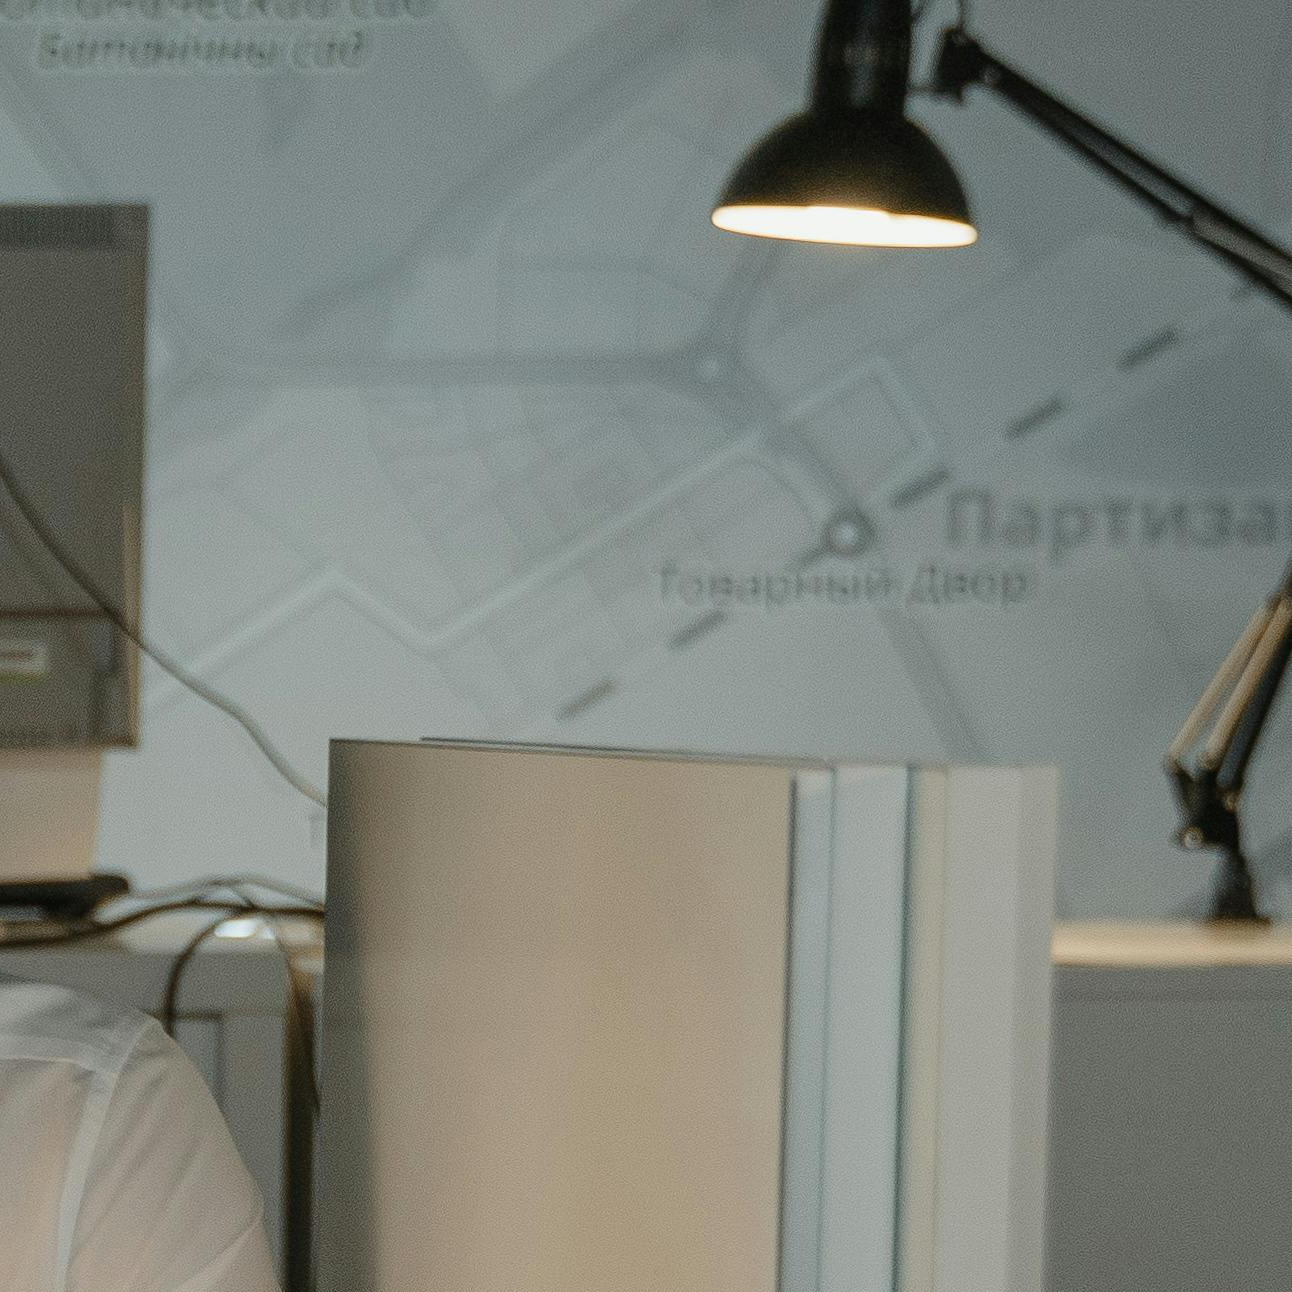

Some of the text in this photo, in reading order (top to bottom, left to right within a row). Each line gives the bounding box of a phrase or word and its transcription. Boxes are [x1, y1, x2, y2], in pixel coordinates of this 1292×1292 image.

[946, 488, 1292, 564] Партиза
[657, 559, 1035, 608] Товарный Двор
